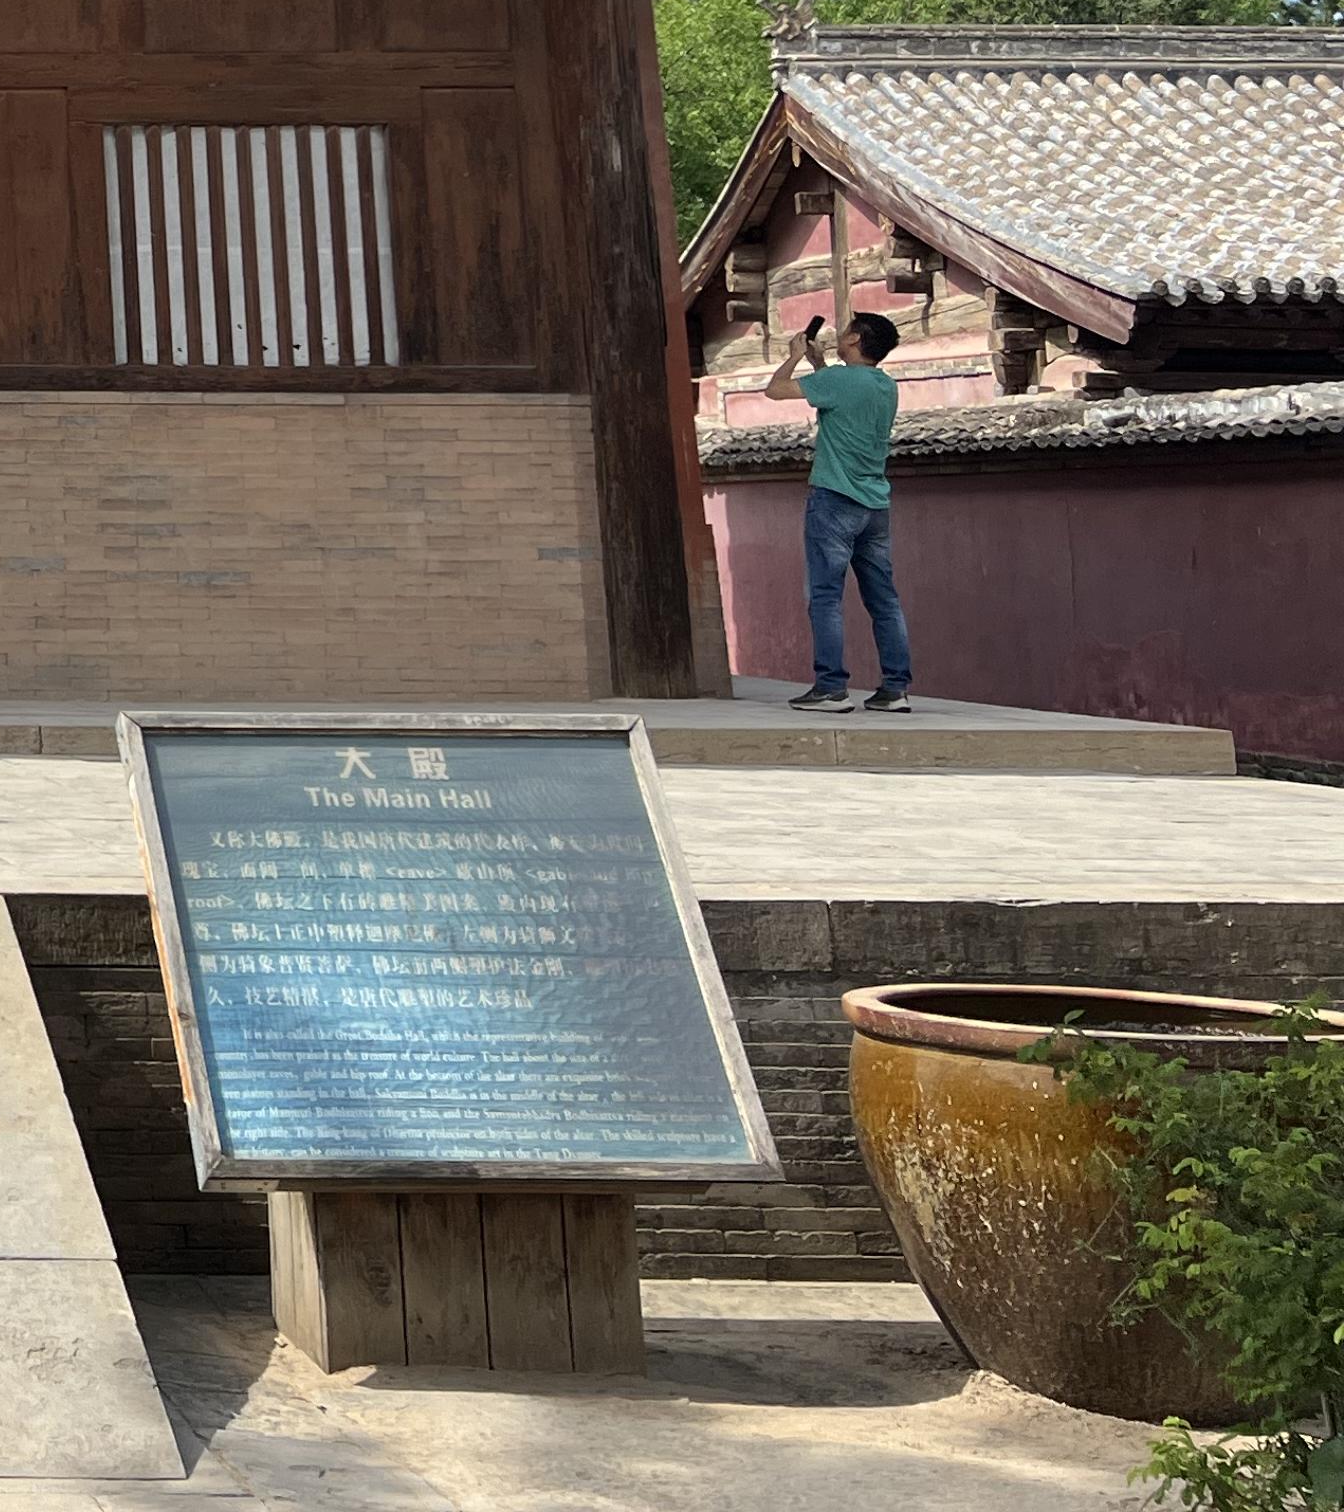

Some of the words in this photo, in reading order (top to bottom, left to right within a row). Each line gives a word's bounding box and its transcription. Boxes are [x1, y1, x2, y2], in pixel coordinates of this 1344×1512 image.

[304, 786, 355, 808] The
[362, 787, 431, 809] Main
[439, 788, 492, 810] Hall
